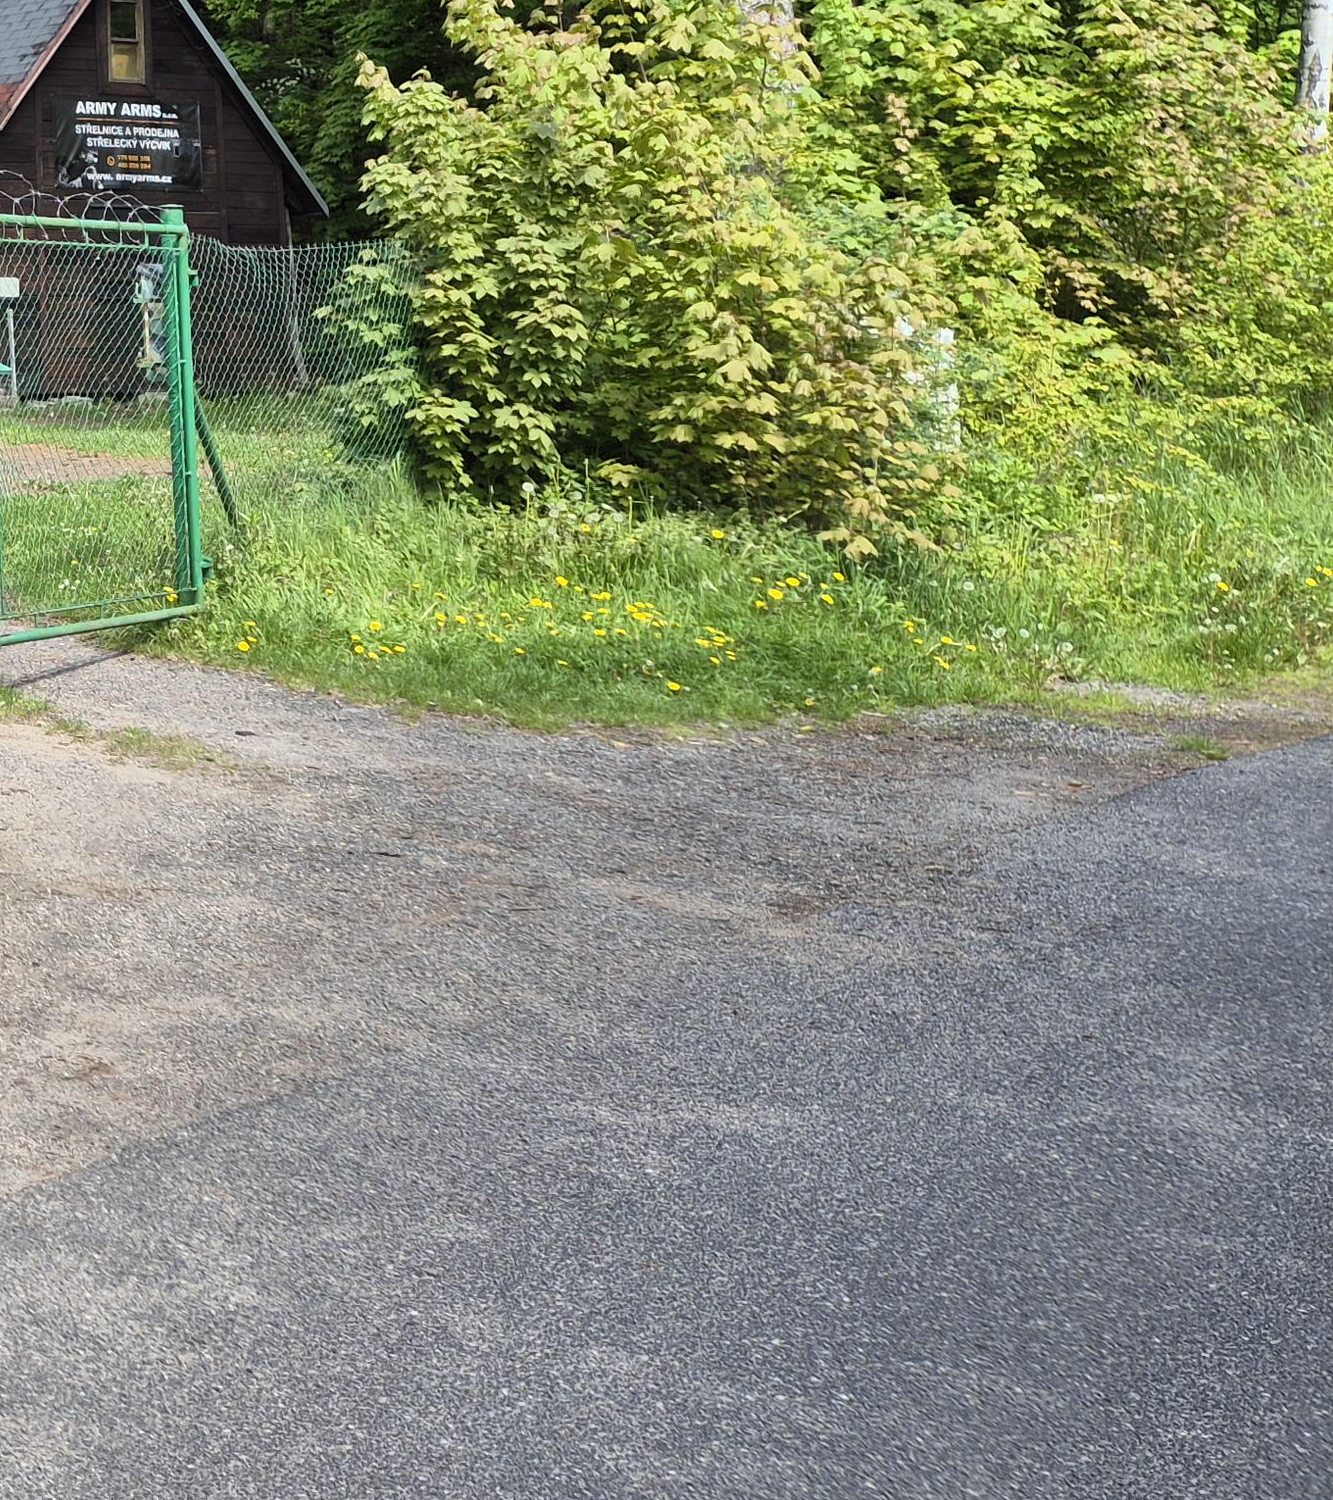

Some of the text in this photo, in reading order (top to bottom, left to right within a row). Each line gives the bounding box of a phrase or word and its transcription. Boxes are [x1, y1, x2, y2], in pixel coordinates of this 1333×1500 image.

[75, 101, 117, 116] ARMY
[121, 102, 161, 118] ARMS
[75, 123, 179, 138] STŘELNICE A PRODEJNA
[87, 136, 171, 150] STŘELECKÝ VÝCVIK
